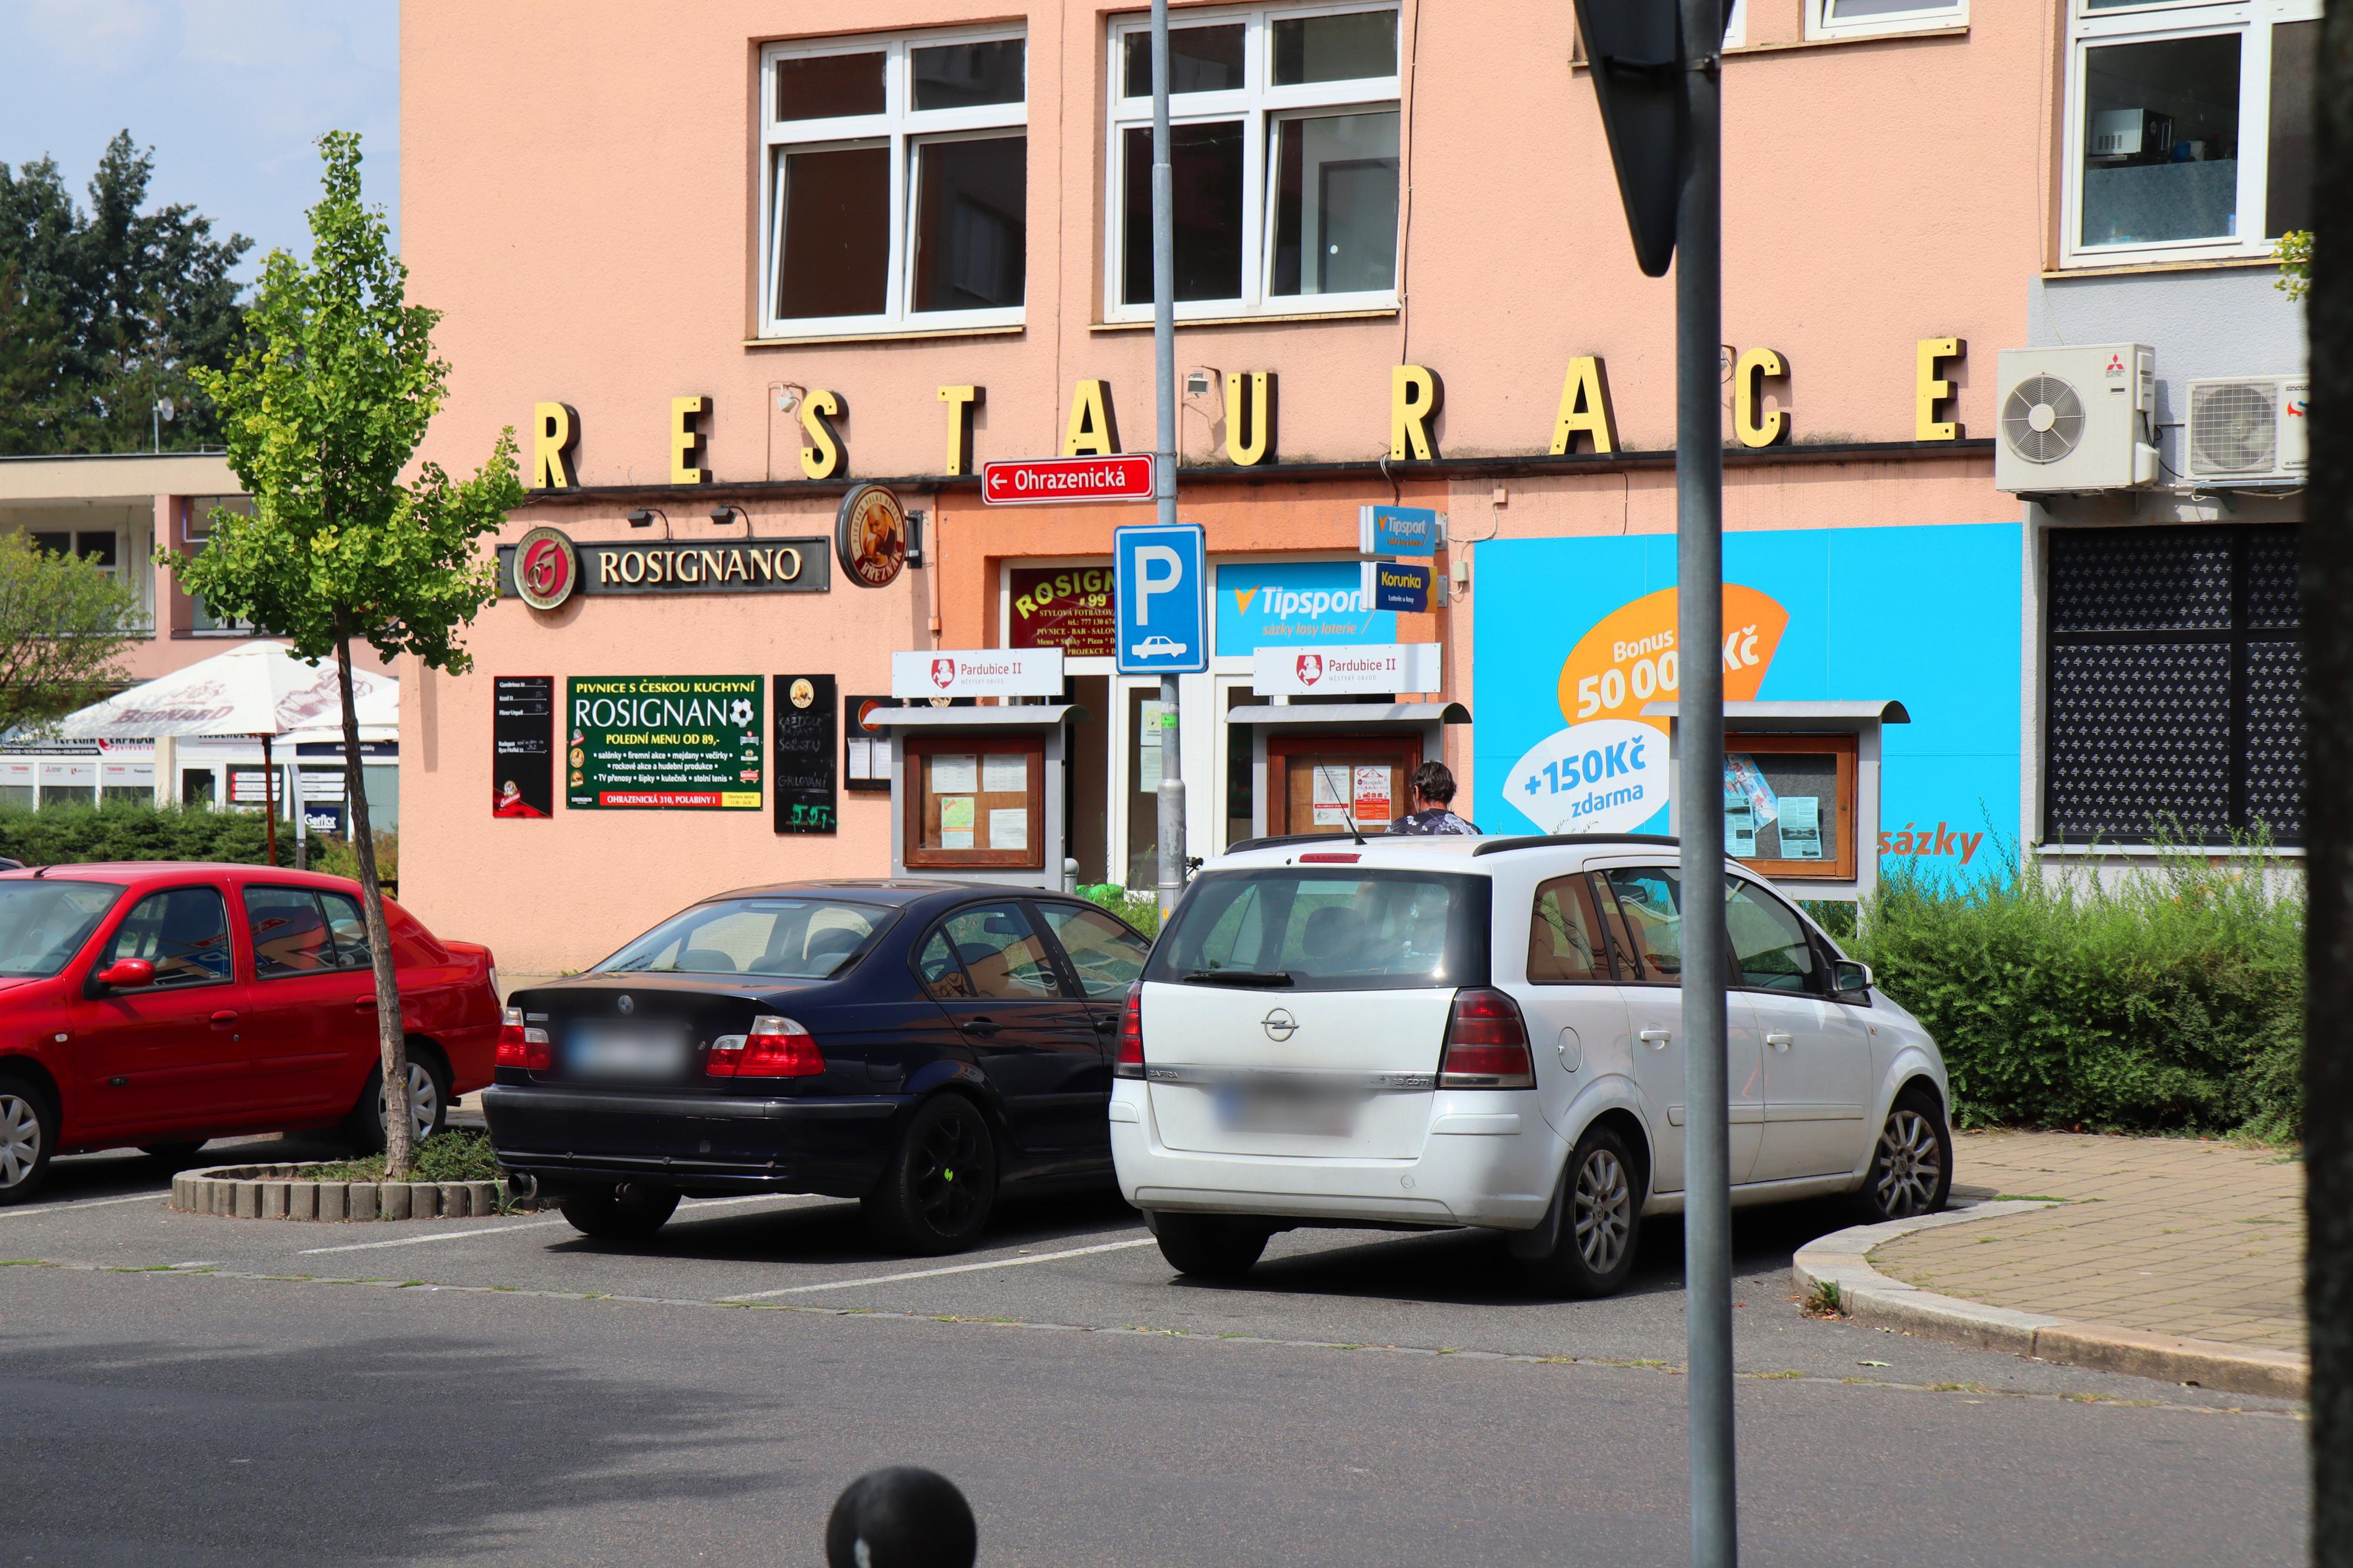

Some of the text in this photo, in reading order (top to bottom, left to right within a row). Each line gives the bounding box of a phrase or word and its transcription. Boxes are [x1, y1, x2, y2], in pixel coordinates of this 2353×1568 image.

[1014, 465, 1126, 491] Ohrazenická
[1388, 516, 1427, 537] Tipsport
[598, 547, 802, 584] ROSIGNANO
[1135, 545, 1183, 626] P
[1381, 571, 1421, 589] Korunka
[1088, 593, 1106, 608] 99
[1039, 608, 1073, 617] STYLOVÁ
[1262, 622, 1357, 638] sázky losy loterie
[1613, 629, 1675, 663] Bonus
[961, 662, 1022, 675] Pardubice II
[1328, 658, 1397, 672] Pardubice II
[576, 679, 756, 693] PIVNICE S ČESKOU KUCHYNÍ
[112, 705, 235, 725] BERNARD
[605, 732, 649, 745] POLEDNÍ
[651, 734, 681, 745] MENU
[685, 734, 700, 744] OD
[598, 752, 622, 761] salónky
[672, 752, 699, 761] mejdany
[705, 752, 728, 760] večírky
[612, 762, 636, 770] rockové
[658, 762, 684, 770] hudební
[684, 763, 713, 772] produkce
[598, 773, 728, 783] TV přenosy šipky kulečník stolní tenis
[778, 772, 828, 788] GRILOVÁNÍ
[606, 794, 658, 804] OHRAZENICKÁ
[659, 796, 674, 805] 310,
[675, 795, 711, 804] POLABINY
[1571, 784, 1644, 818] zdarma
[1878, 821, 1985, 865] sázky
[1149, 1070, 1179, 1078] ZAFIRA
